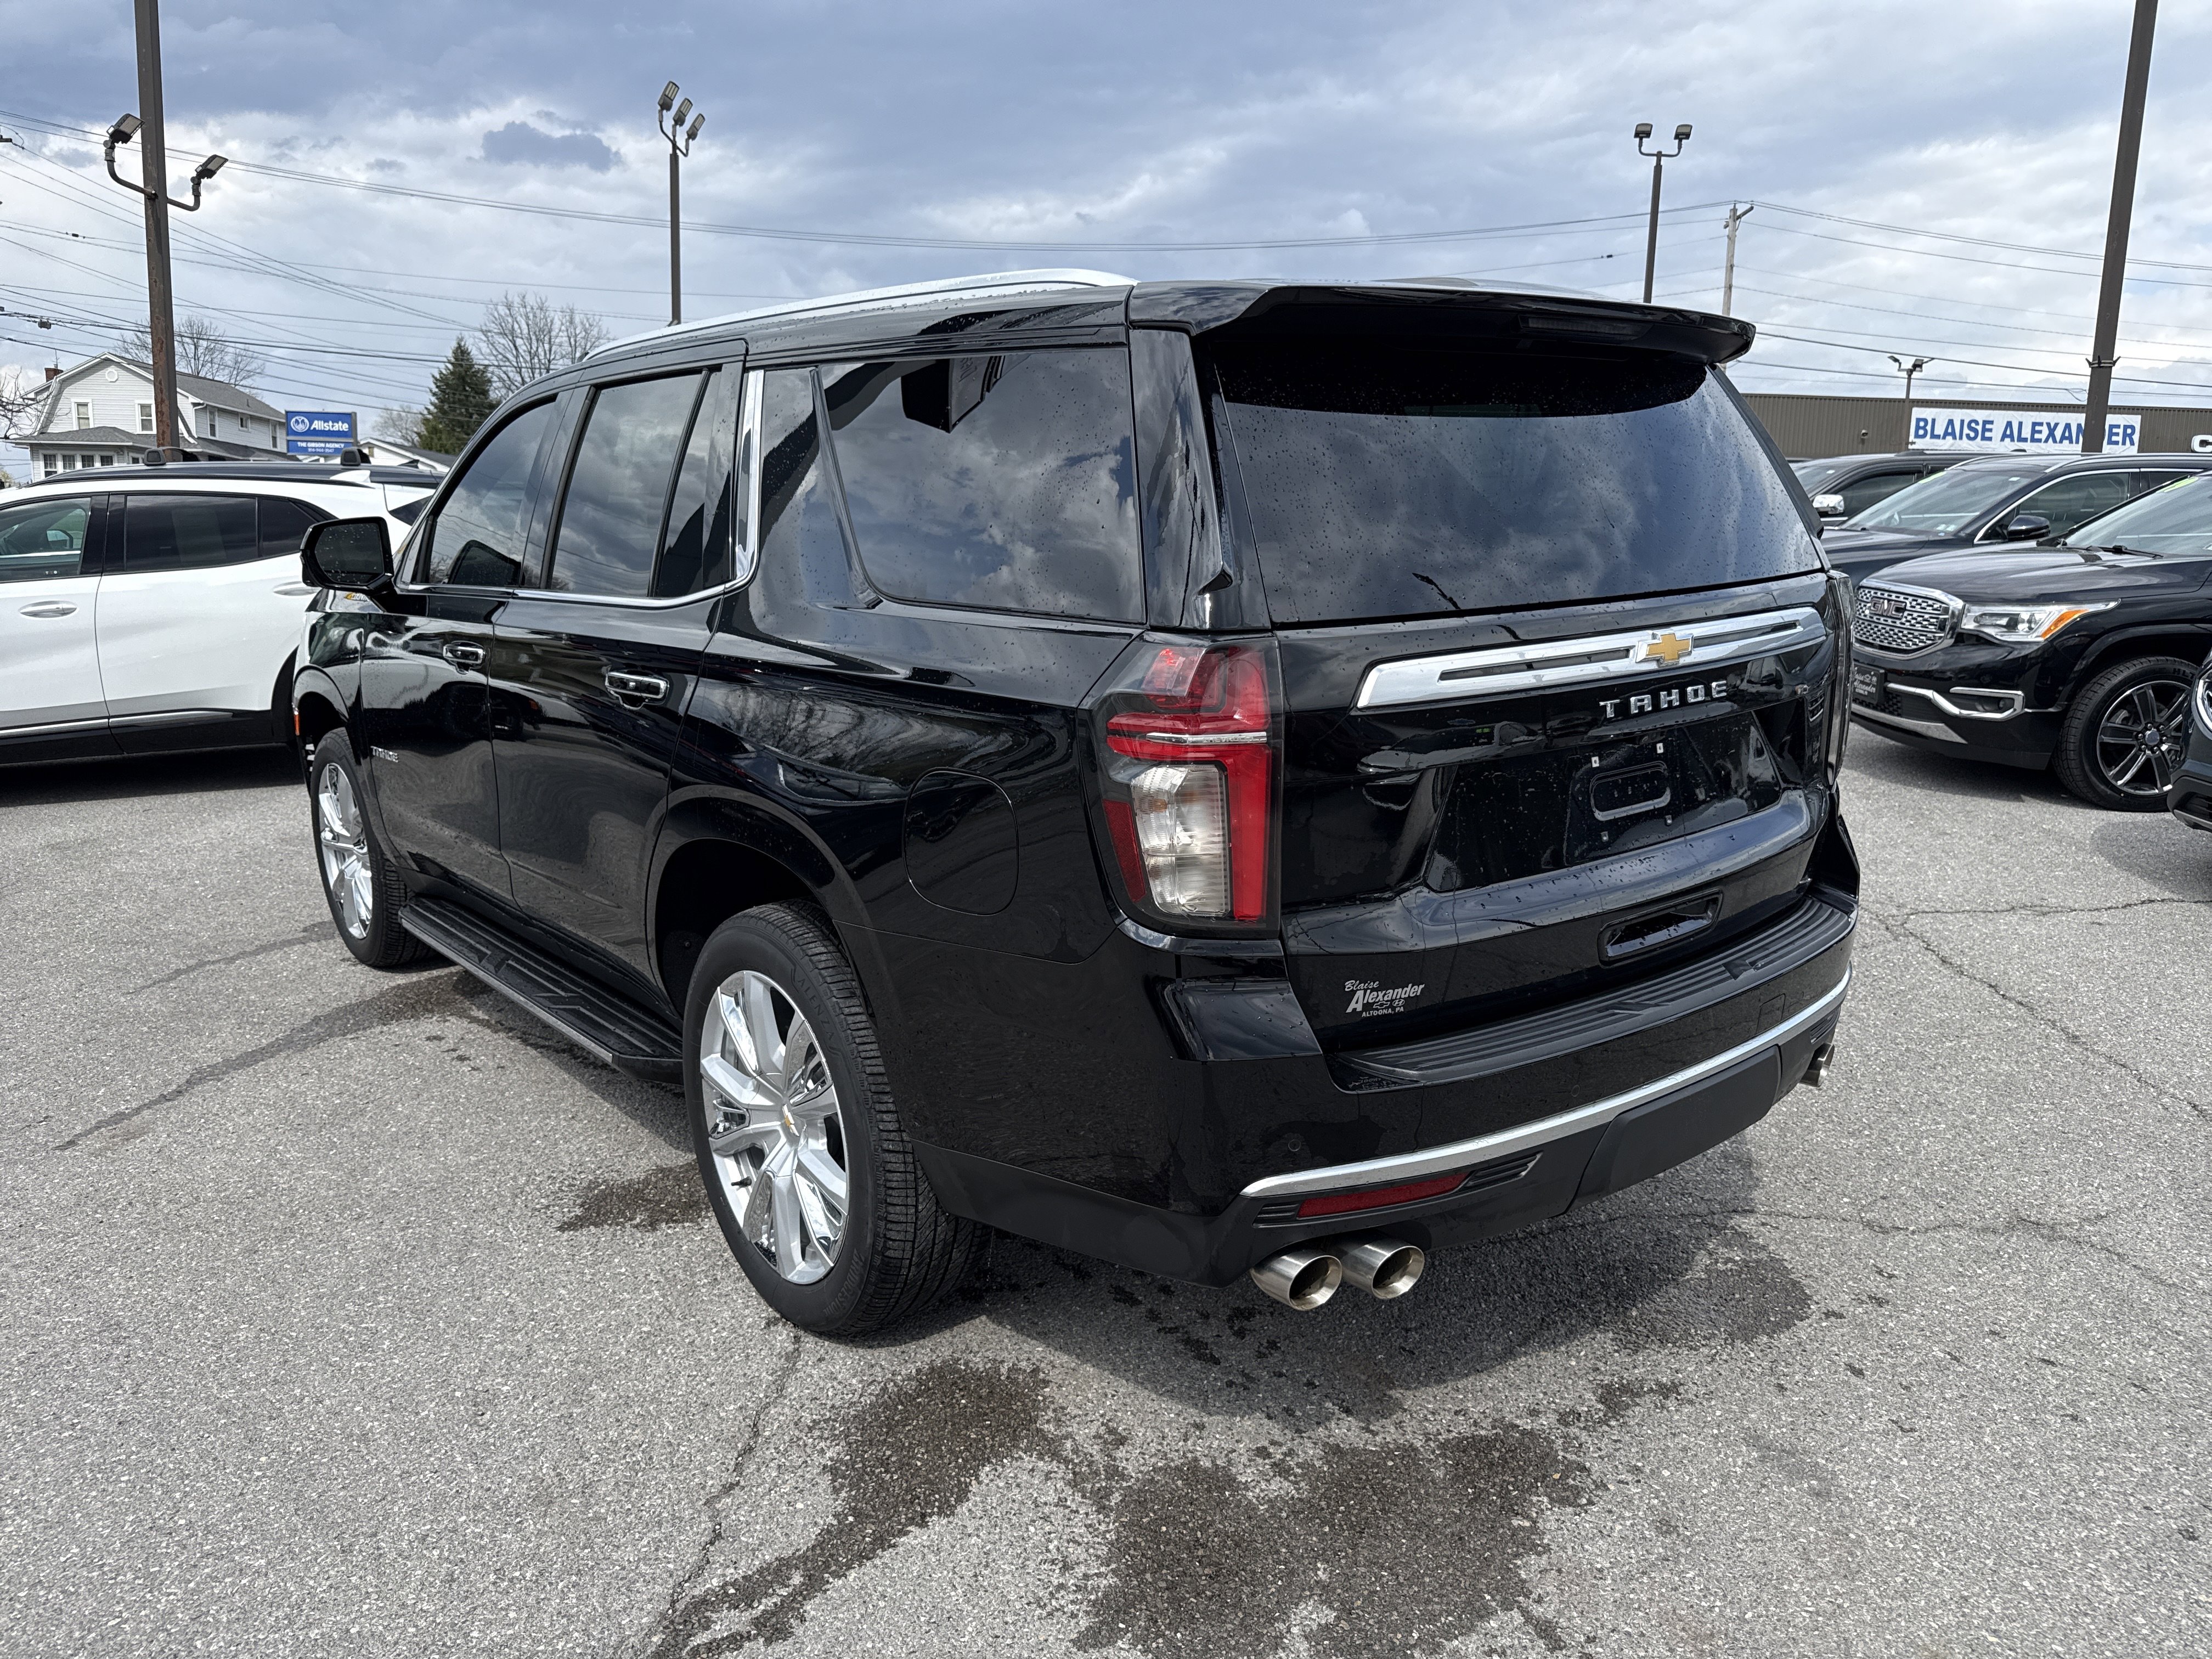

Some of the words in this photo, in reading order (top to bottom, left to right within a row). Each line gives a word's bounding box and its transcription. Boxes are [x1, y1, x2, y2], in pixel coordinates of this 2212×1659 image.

[310, 420, 349, 431] Allstate
[1914, 417, 1994, 442] BLAISE
[2000, 421, 2136, 446] ALEXANER
[1869, 597, 1906, 619] GMC
[1599, 680, 1727, 719] TAHOE
[370, 746, 398, 763] TAHOE
[1345, 980, 1380, 991] Blaise
[798, 978, 834, 1040] ALENZA
[1346, 984, 1425, 1013] Alexander
[1362, 1008, 1395, 1017] ALTOONA,
